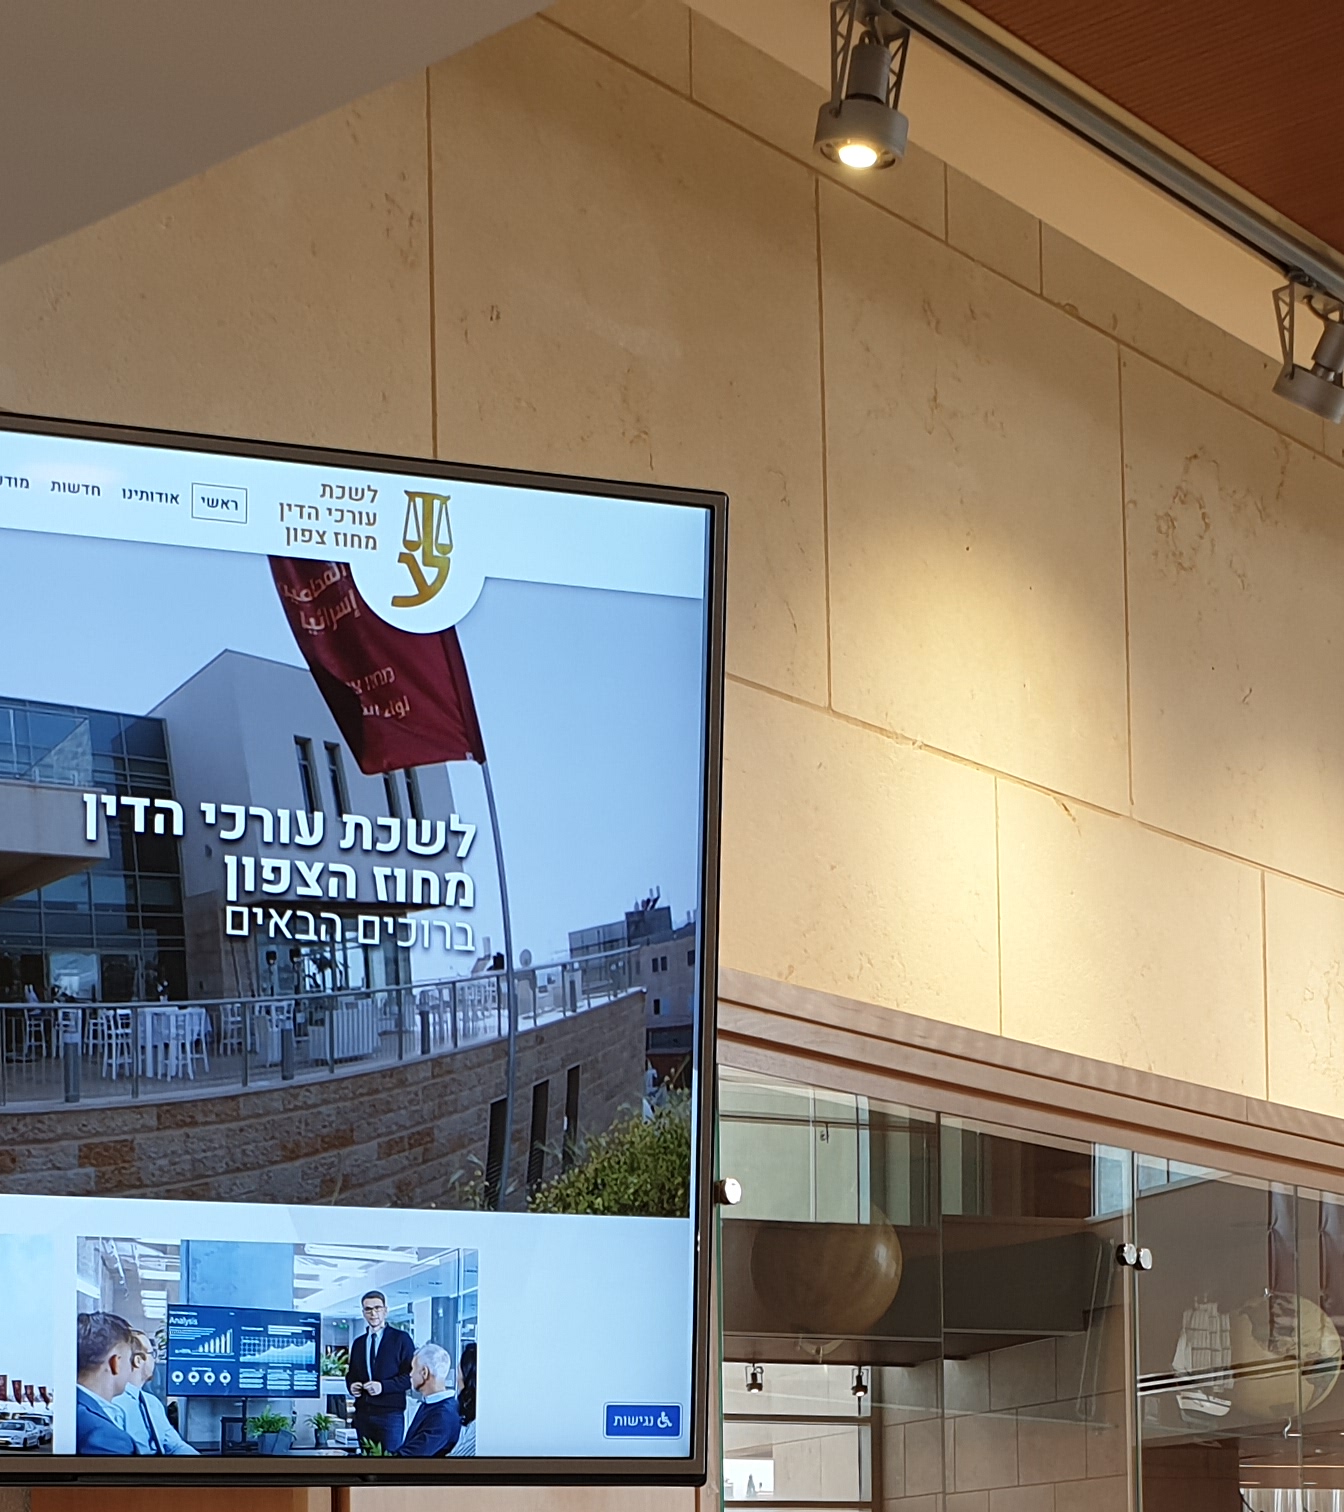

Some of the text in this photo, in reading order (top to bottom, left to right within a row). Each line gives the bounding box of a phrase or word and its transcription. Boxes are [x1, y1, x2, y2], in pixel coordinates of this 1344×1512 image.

[51, 479, 101, 497] חדשות
[121, 486, 180, 505] אודותינו
[319, 482, 378, 504] לשכת
[200, 494, 239, 512] ראשי
[279, 502, 377, 527] עורכי הדין
[285, 525, 377, 551] מחוז צפון
[83, 793, 477, 858] לשכת עורכי הדין
[224, 855, 474, 908] מחוז הצפון
[225, 906, 476, 951] ברוכים הבאים
[613, 1415, 654, 1427] נגישות
